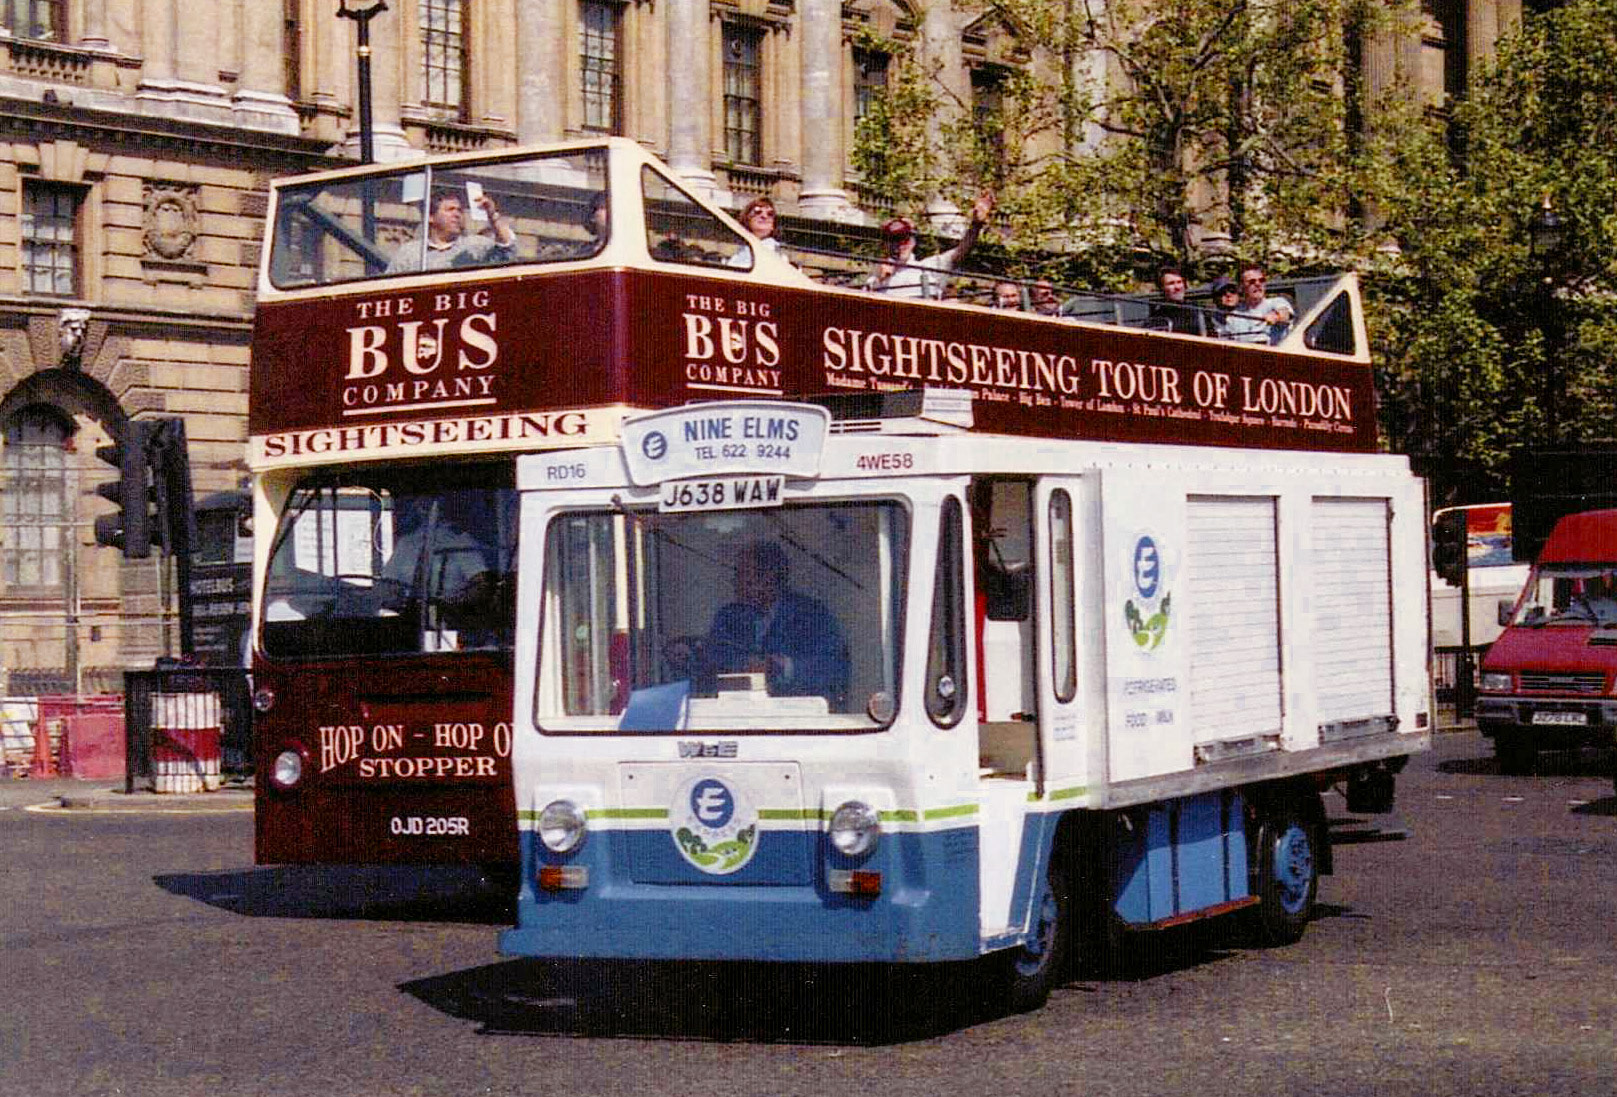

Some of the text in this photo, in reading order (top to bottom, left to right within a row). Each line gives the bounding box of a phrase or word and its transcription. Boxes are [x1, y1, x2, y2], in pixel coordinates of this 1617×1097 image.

[356, 290, 490, 319] THE BIG
[686, 294, 771, 318] THE BIG
[344, 312, 499, 380] BUS
[683, 312, 780, 367] BUS
[686, 363, 782, 388] COMPANY
[823, 326, 1351, 421] SIGHTSEEING TOUR OF LONDON
[343, 375, 497, 407] COMPANY
[264, 412, 588, 458] SIGHTSEEING
[684, 416, 800, 442] NINE ELMS
[695, 444, 791, 460] TEL 622 9244
[856, 453, 914, 470] 4WE58
[547, 463, 586, 480] RD16
[664, 478, 782, 508] J638 WAW
[319, 725, 364, 773] HOP
[372, 724, 404, 752] ON
[434, 722, 484, 750] HOP
[493, 721, 514, 757] O
[359, 756, 498, 778] STOPPER
[391, 816, 470, 836] OJD 205R
